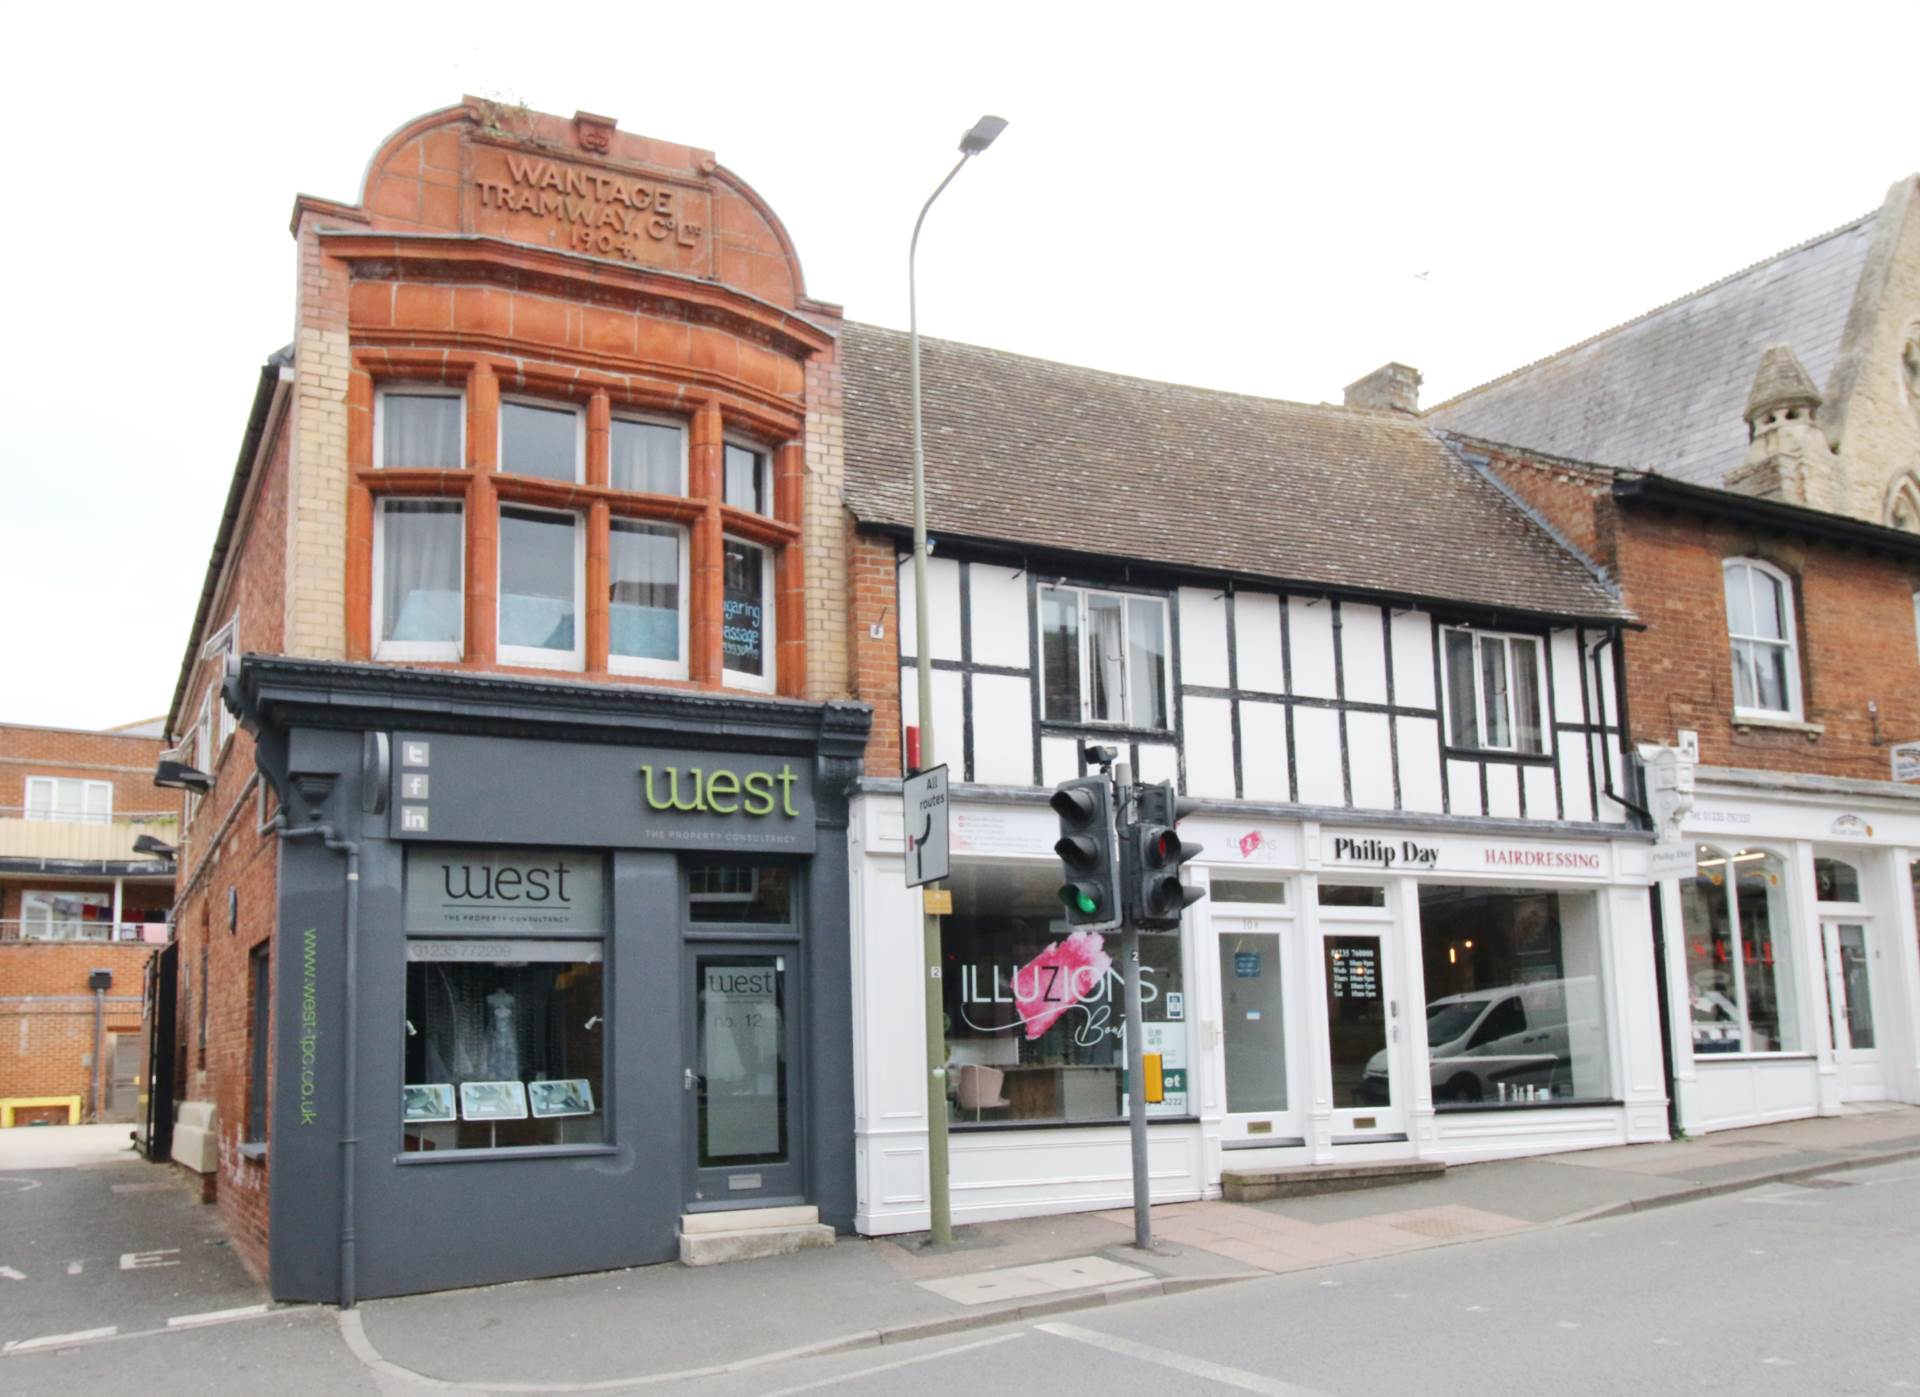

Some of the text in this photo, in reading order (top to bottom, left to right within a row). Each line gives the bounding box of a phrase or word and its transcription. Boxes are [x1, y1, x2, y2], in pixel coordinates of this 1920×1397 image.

[506, 155, 673, 217] WANTAGE
[640, 764, 800, 816] west
[926, 776, 938, 792] All
[919, 794, 945, 811] routes
[644, 829, 798, 844] THE PROPERTY CONSULTANCY
[1334, 837, 1600, 869] Philip Day HAIRDRESSING
[441, 862, 571, 902] west
[443, 914, 569, 923] THE PROPERTY CONSULTANCY
[1132, 952, 1139, 961] 2
[933, 967, 940, 977] 2
[708, 972, 773, 993] west
[301, 928, 317, 1126] www.west-tpc.co.uk
[745, 1013, 762, 1027] 12
